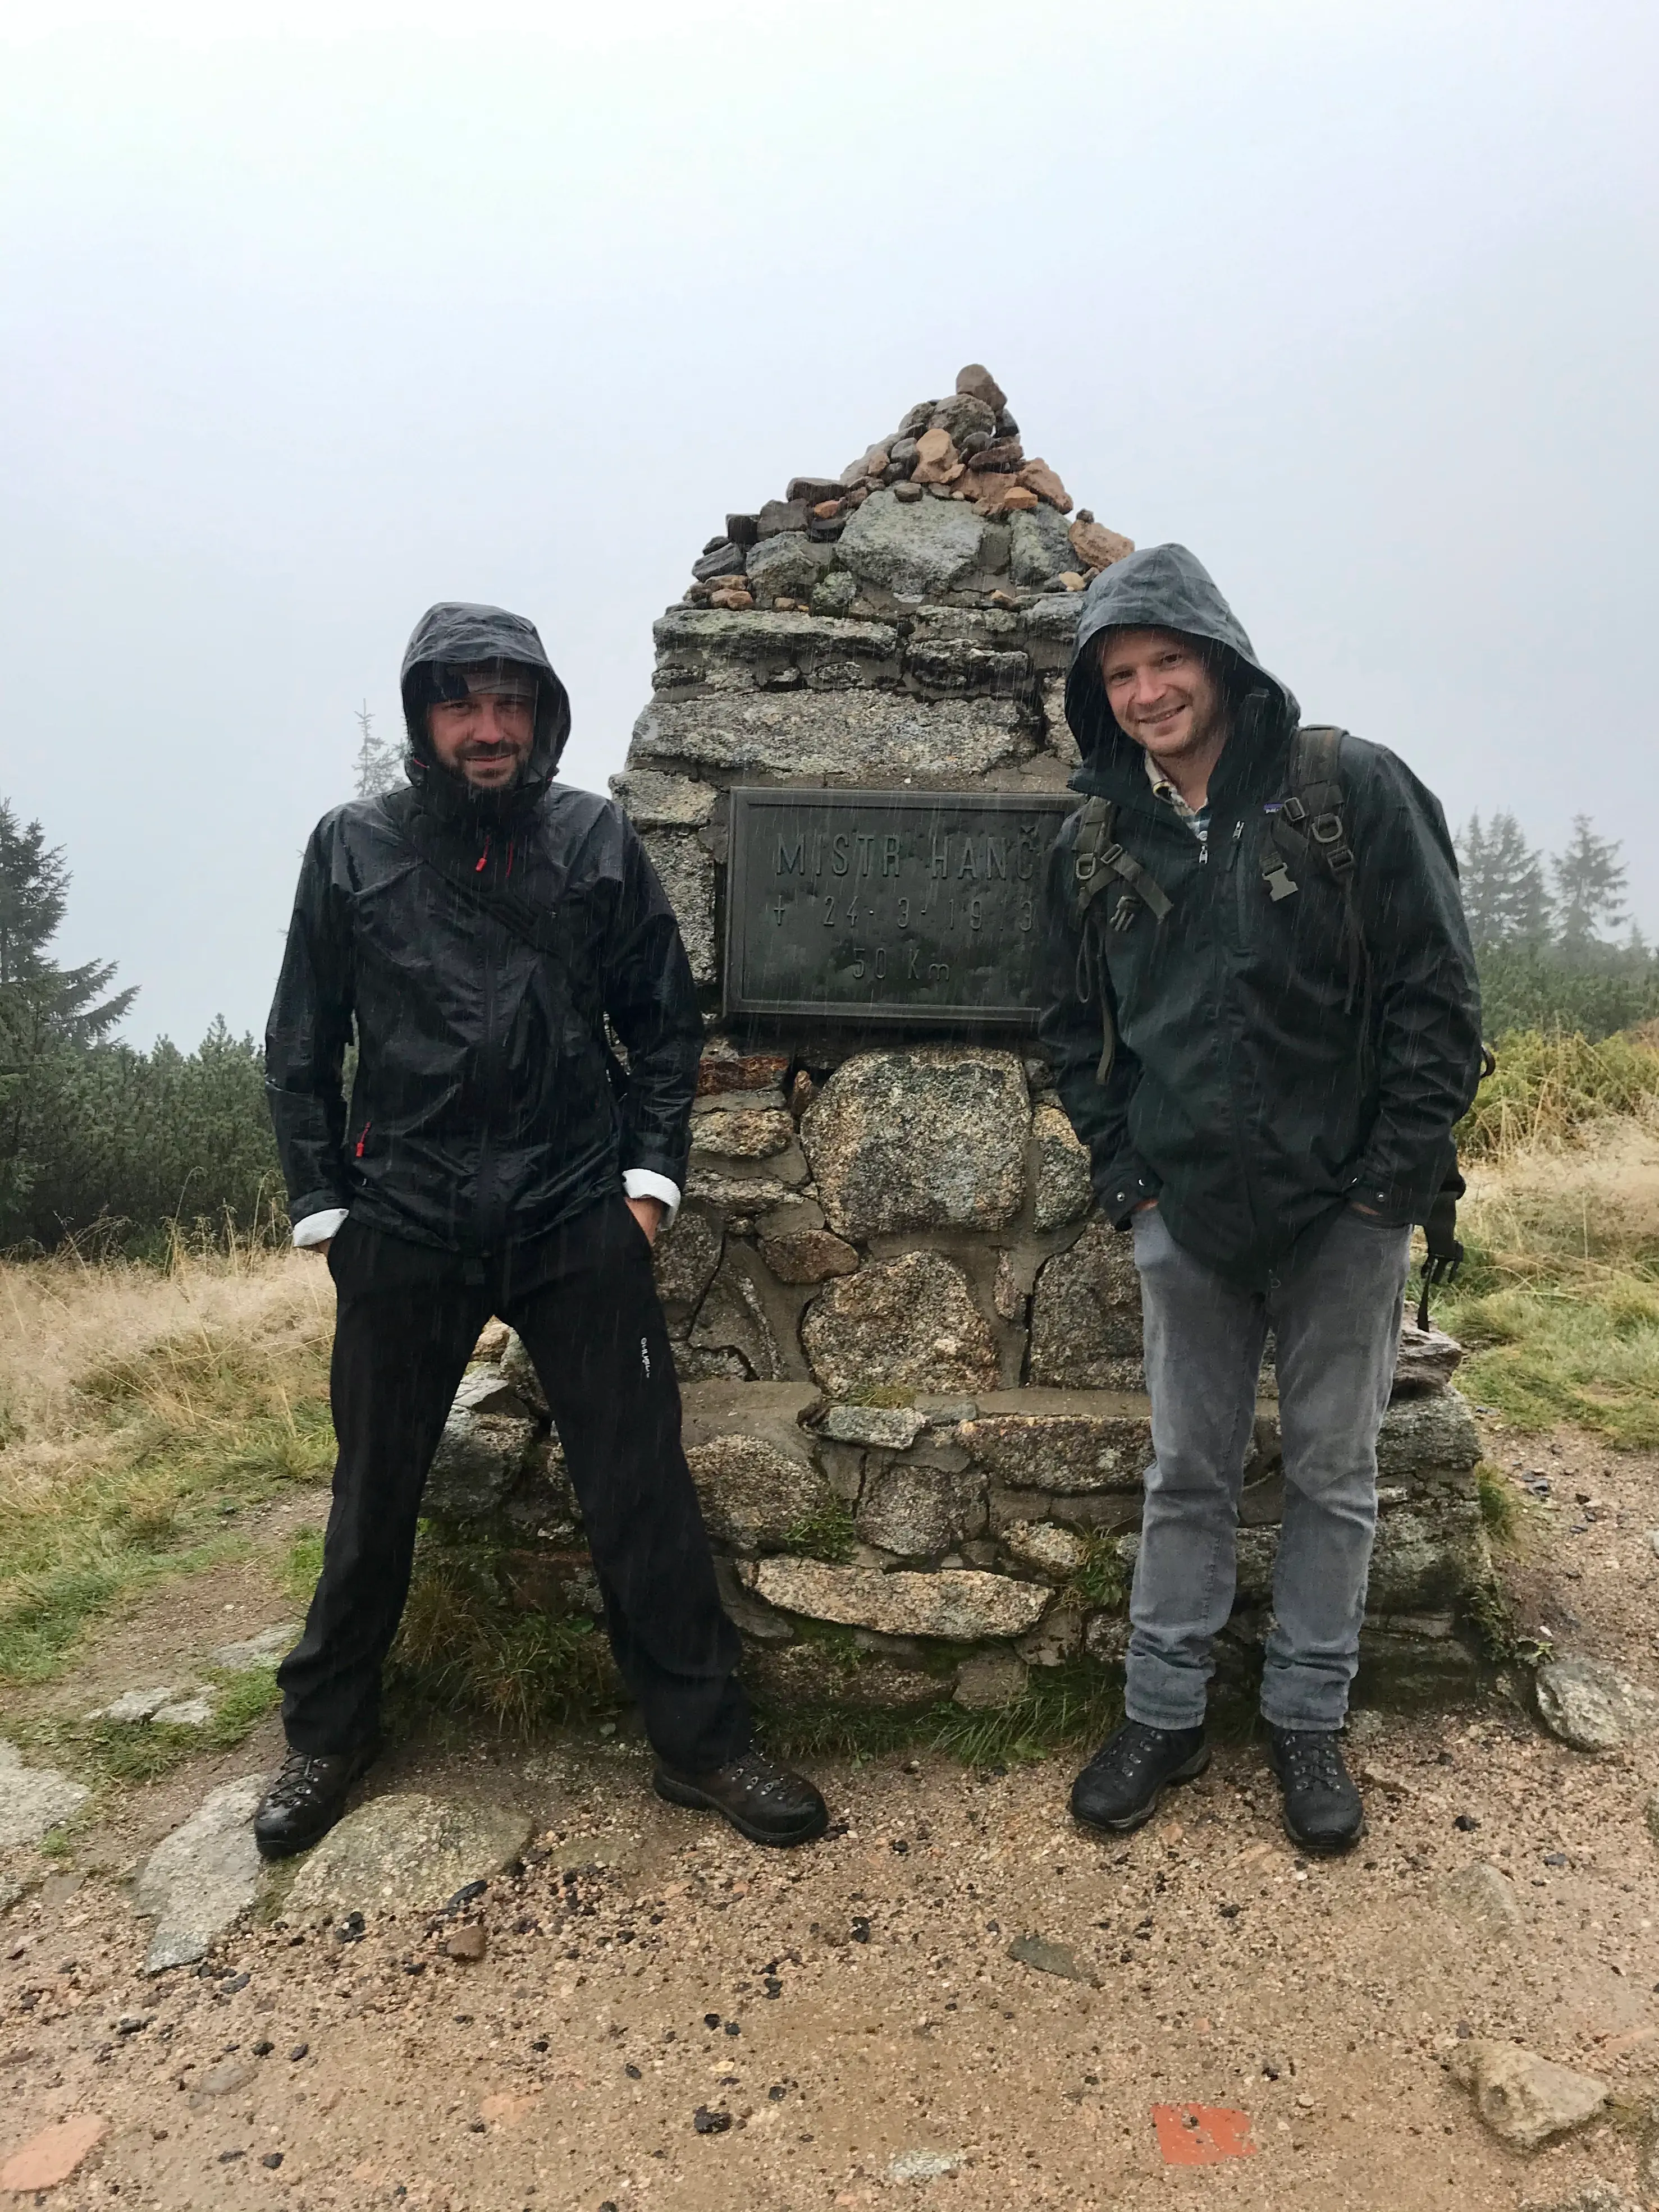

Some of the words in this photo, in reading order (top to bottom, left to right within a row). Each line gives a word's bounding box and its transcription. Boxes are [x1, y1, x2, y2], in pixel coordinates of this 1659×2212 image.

[776, 832, 900, 877] MISTR
[931, 825, 1034, 881] HANČ
[853, 947, 886, 979] 50
